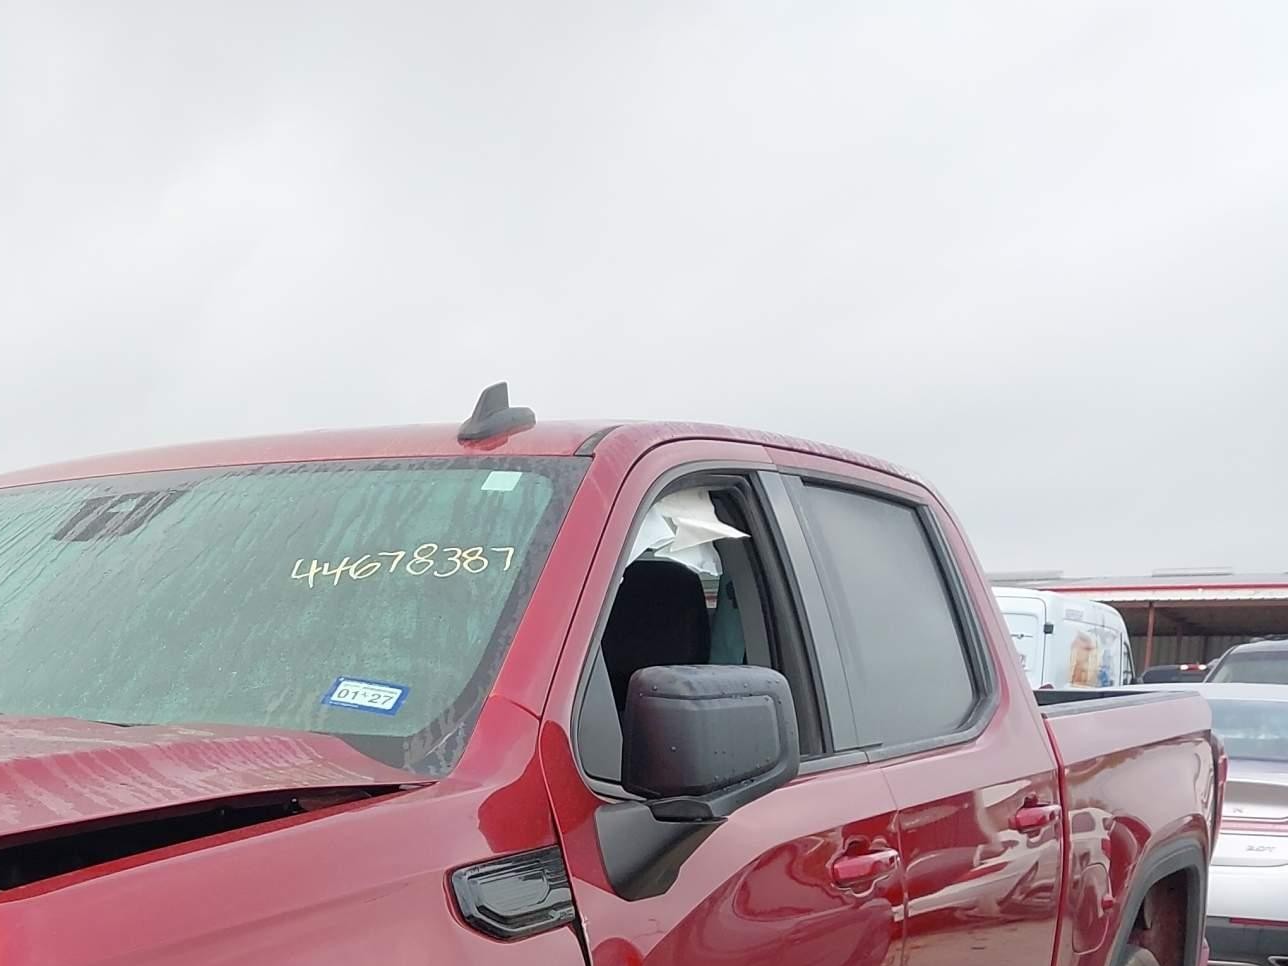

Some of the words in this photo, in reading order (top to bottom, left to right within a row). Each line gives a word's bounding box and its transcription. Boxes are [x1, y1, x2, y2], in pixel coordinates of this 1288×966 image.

[290, 543, 515, 588] 44678387
[337, 688, 360, 700] 01
[367, 693, 393, 705] 27
